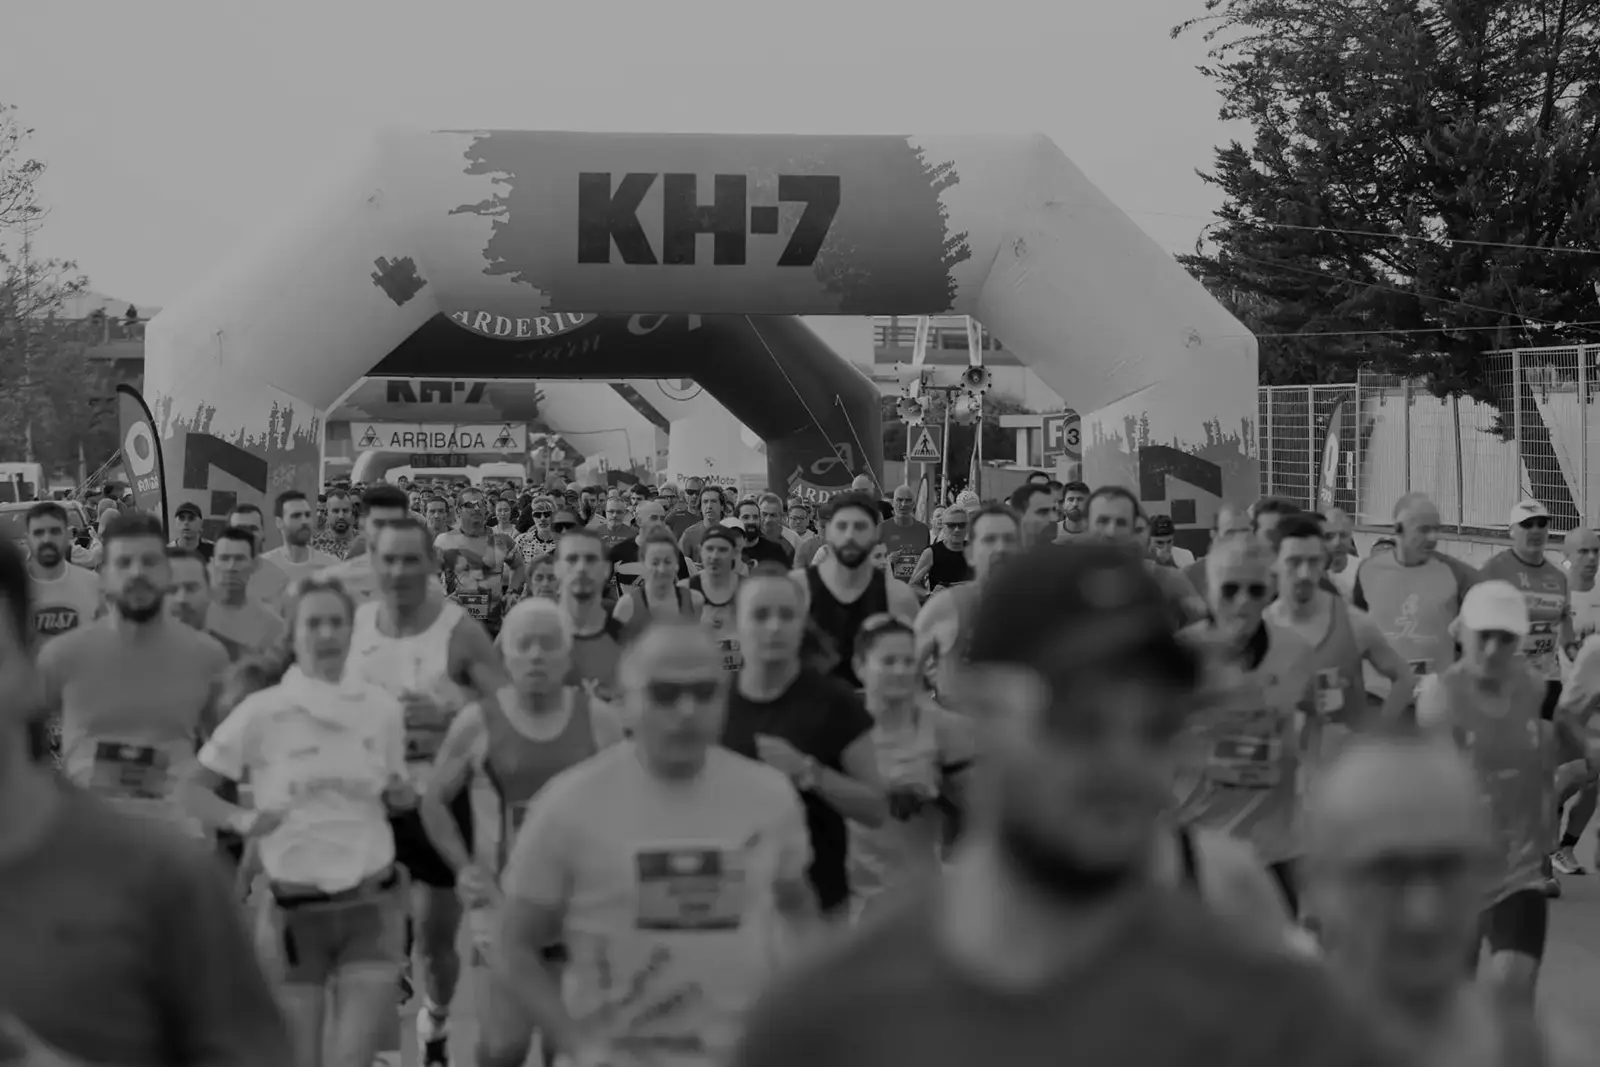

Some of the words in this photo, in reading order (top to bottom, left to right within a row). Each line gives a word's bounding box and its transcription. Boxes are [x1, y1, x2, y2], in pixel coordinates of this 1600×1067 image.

[578, 172, 841, 267] KH-7
[390, 431, 485, 449] ARRIBADA
[1067, 428, 1080, 446] 3
